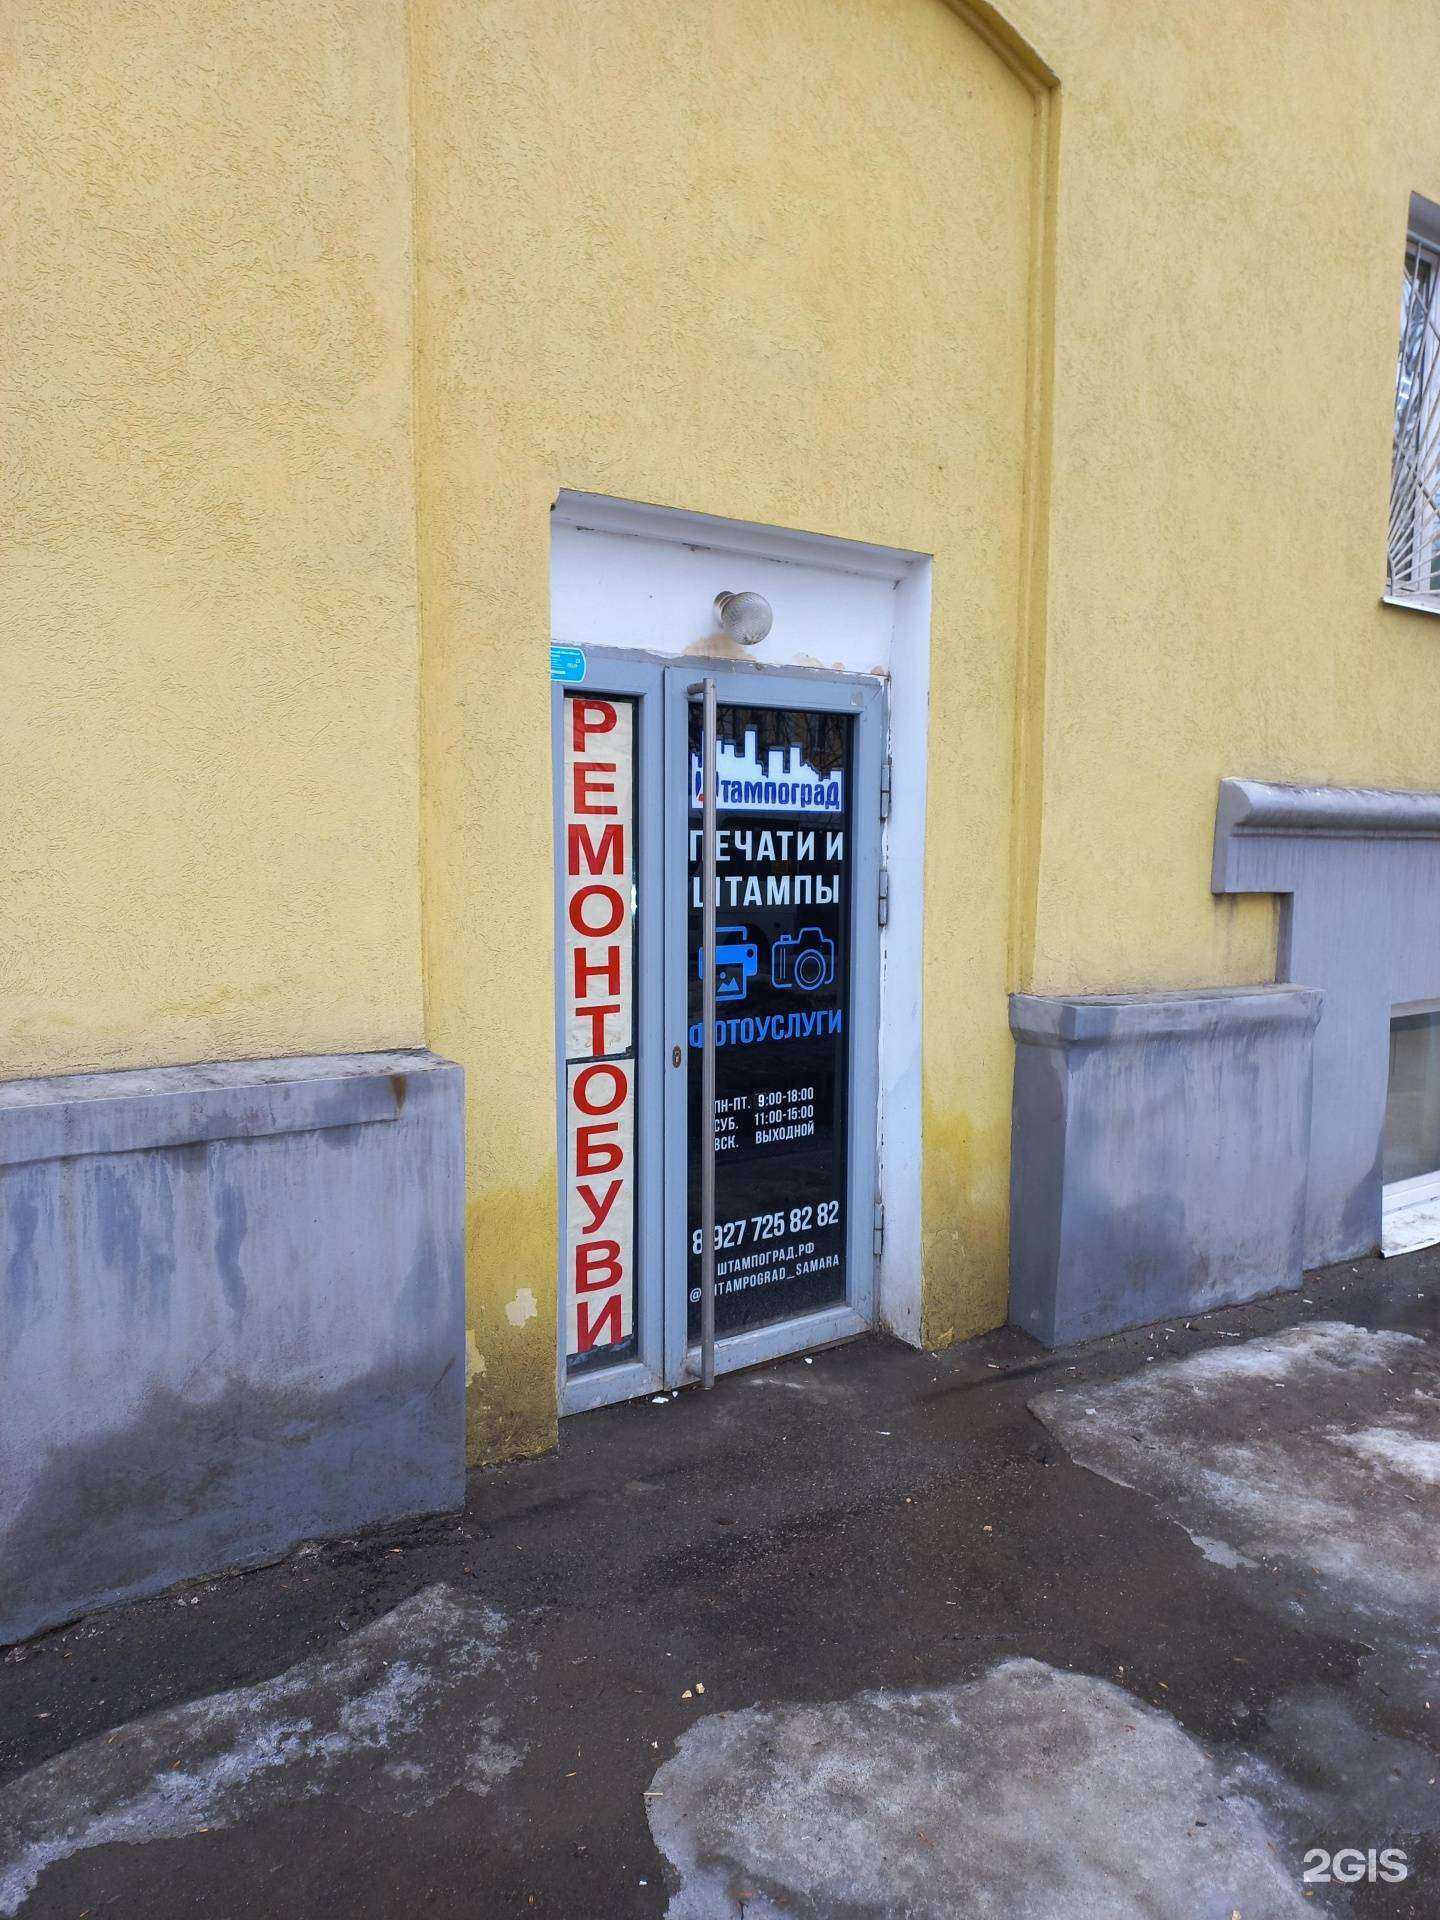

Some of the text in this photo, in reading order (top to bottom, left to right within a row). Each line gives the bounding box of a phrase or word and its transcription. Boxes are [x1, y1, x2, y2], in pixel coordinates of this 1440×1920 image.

[689, 830, 844, 862] ПЕЧАТИ И
[567, 698, 625, 1057] РЕМОНТ
[758, 1086, 814, 1107] 9:00-18:00
[754, 1104, 814, 1126] 11:00-15:00
[755, 1120, 815, 1145] ВЫХОДНОЙ
[572, 1063, 628, 1353] ОБУВИ
[714, 1219, 747, 1250] 927
[751, 1211, 785, 1242] 725
[789, 1206, 813, 1233] 82
[817, 1200, 840, 1227] 82
[717, 1242, 815, 1276] ШТАМПОГРАД.РФ
